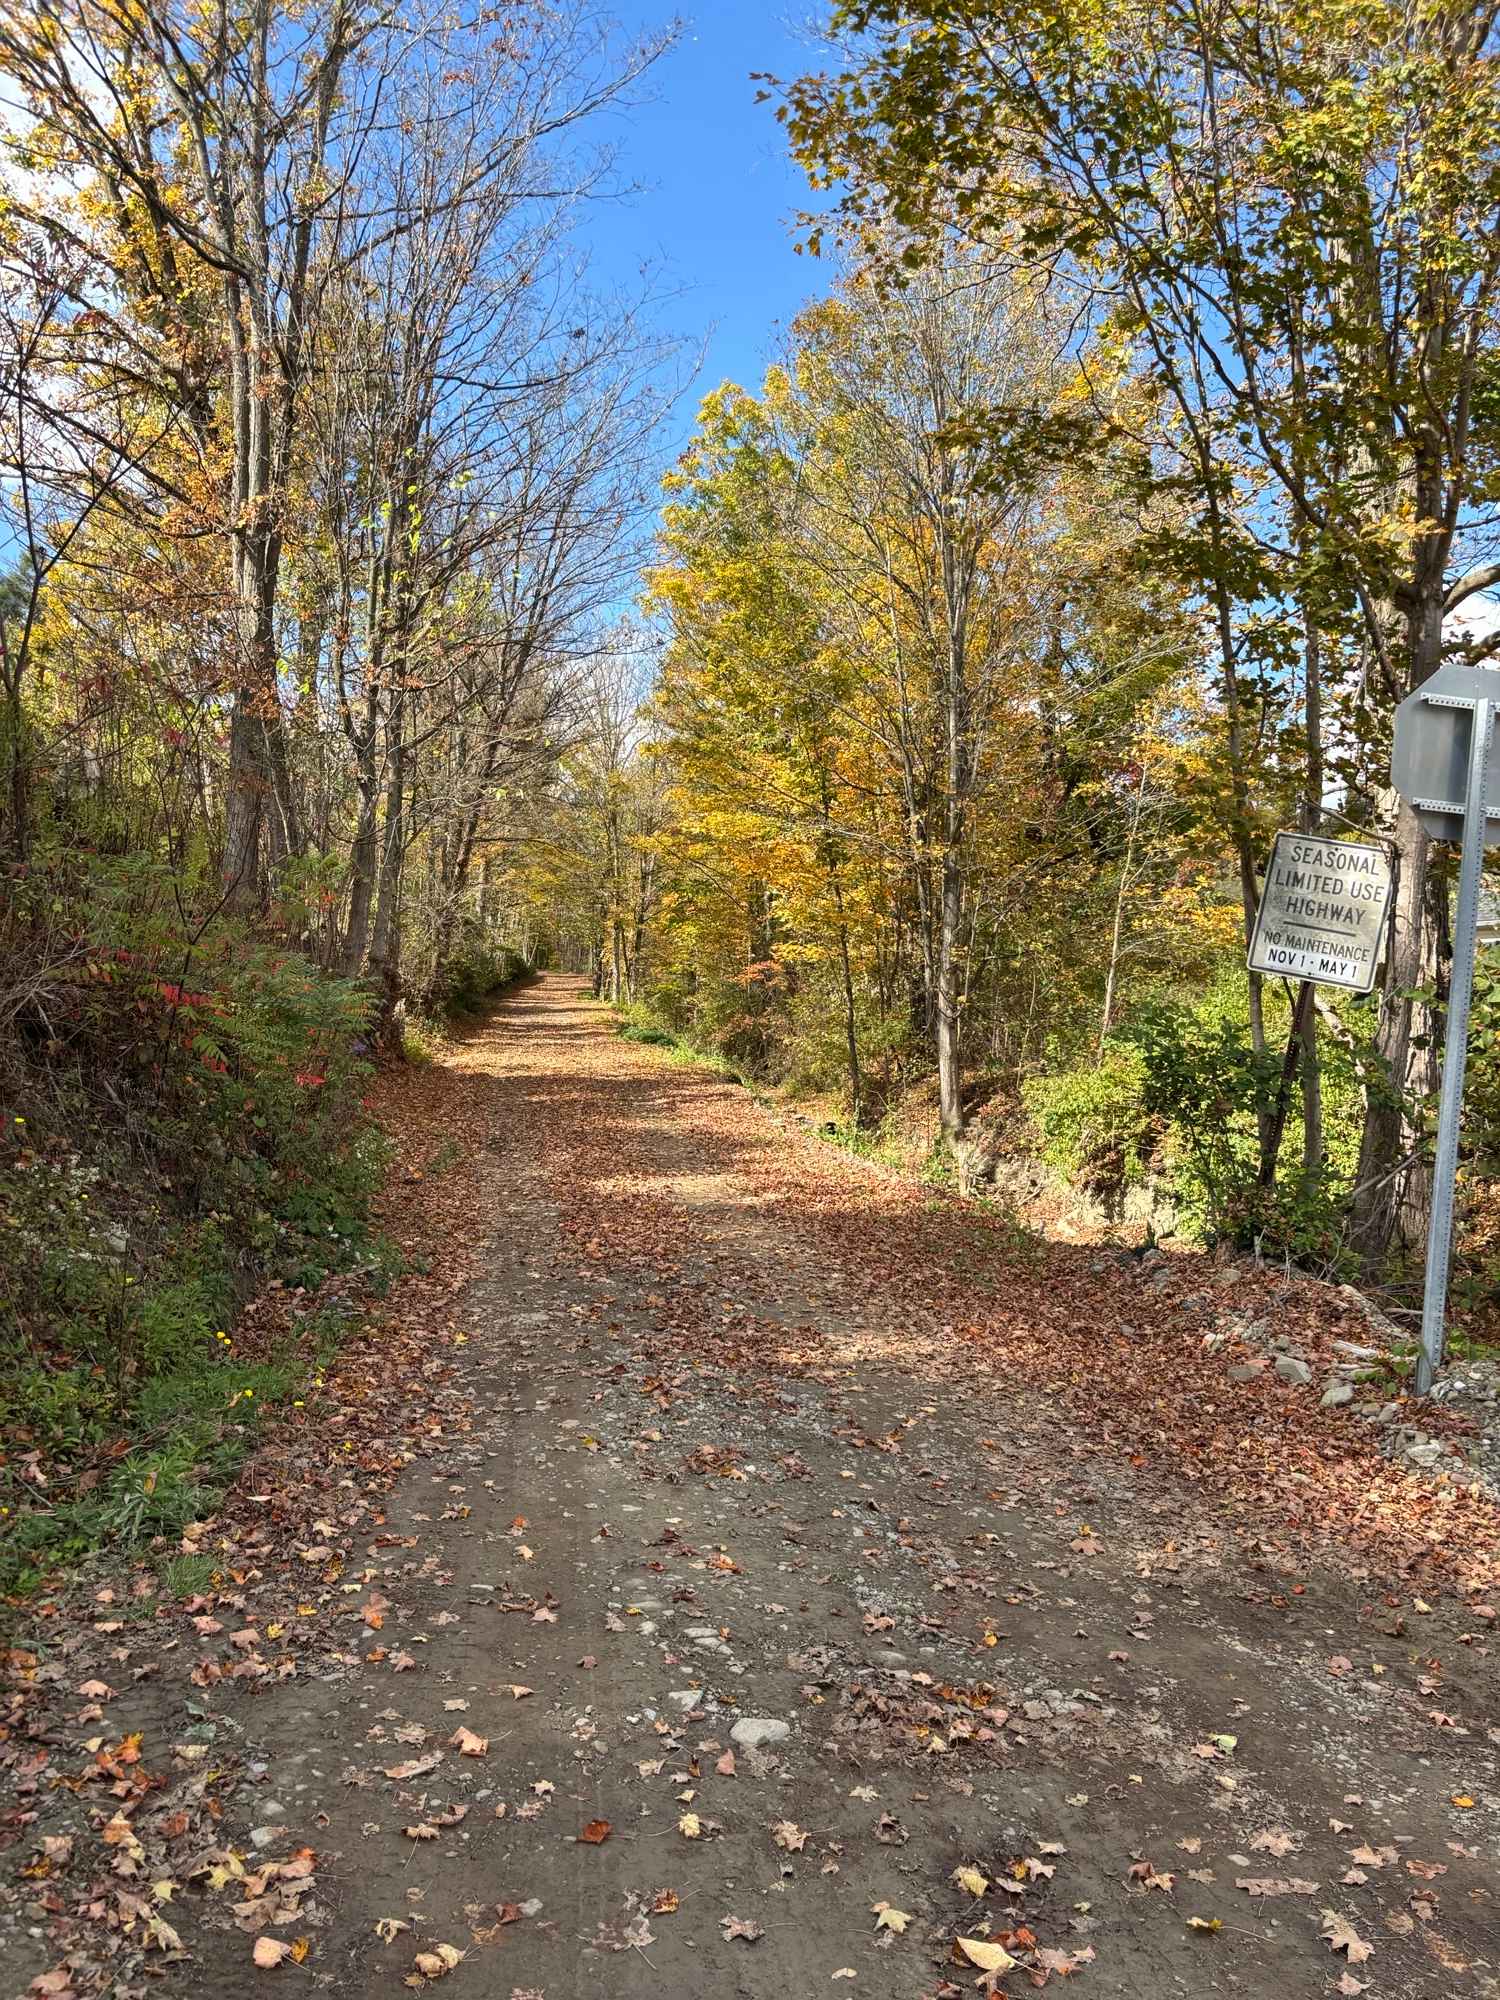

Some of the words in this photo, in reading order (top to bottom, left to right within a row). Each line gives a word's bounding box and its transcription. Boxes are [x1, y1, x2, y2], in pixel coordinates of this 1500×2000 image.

[1291, 845, 1379, 875] SEASONAL
[1275, 869, 1344, 895] LIMITED
[1350, 881, 1385, 903] USE
[1286, 896, 1367, 925] HIGHWAY
[1263, 930, 1280, 945] NO
[1286, 934, 1370, 962] MAINTENANCE
[1268, 949, 1296, 965] NOV
[1300, 955, 1305, 967] 1
[1318, 958, 1348, 978] MAY
[1351, 965, 1357, 978] 1
